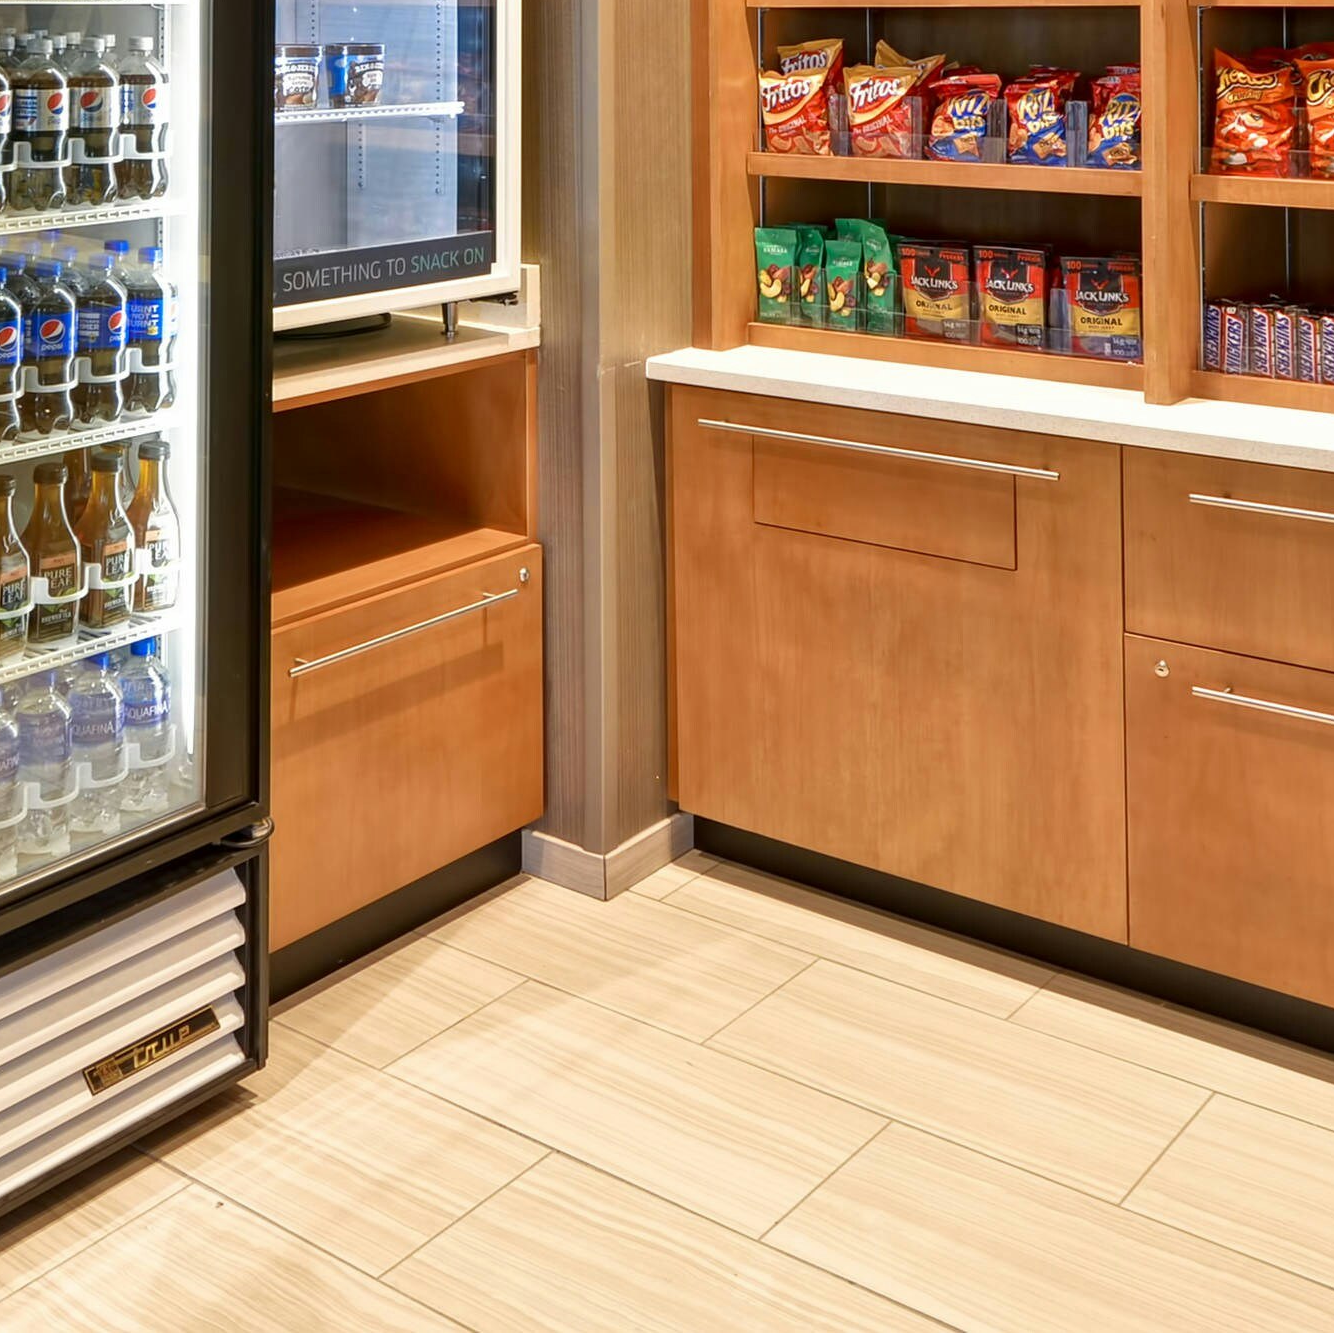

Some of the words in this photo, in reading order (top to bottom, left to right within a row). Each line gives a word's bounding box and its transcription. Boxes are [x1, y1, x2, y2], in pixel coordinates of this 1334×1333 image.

[761, 78, 812, 111] Fritos
[849, 78, 902, 112] Fritos
[1102, 120, 1136, 139] bits
[282, 260, 382, 293] SOMETHING
[386, 257, 407, 277] TO
[410, 249, 460, 274] SNACK
[463, 246, 485, 266] ON
[911, 276, 930, 288] JACK
[985, 278, 1006, 291] JACK
[1075, 289, 1099, 303] JACK
[1099, 290, 1130, 304] LINK'S
[988, 304, 1027, 315] ORIGINAL
[1080, 316, 1123, 326] ORIGINAL
[43, 567, 73, 580] PURE
